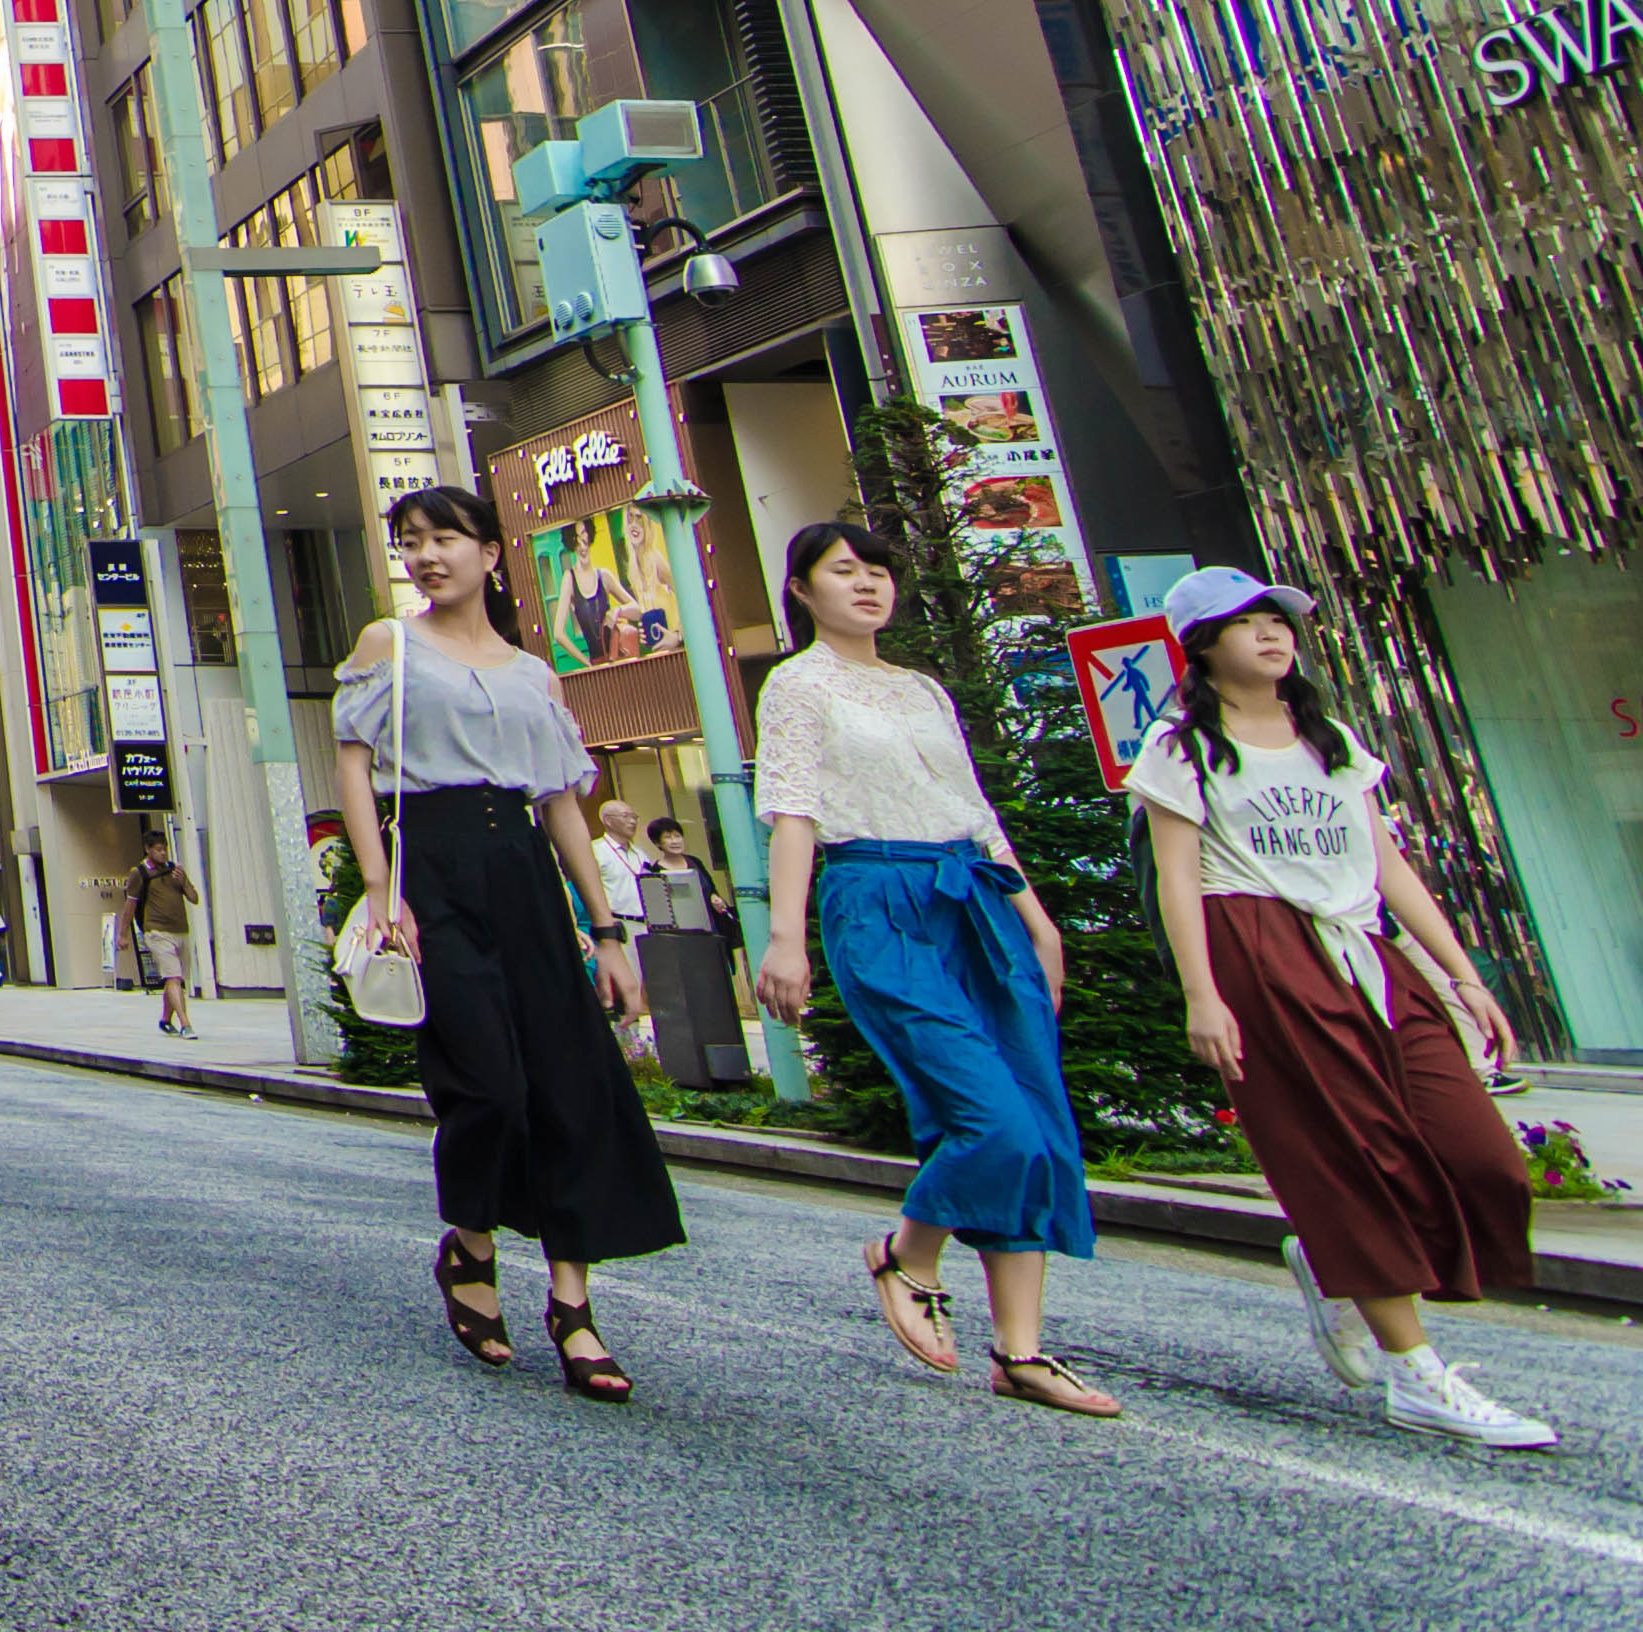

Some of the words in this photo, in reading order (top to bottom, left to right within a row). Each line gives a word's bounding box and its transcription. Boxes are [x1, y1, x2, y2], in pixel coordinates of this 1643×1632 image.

[941, 372, 1018, 388] AURUM
[378, 476, 434, 490] 長崎放送
[535, 445, 575, 506] Folli
[573, 430, 623, 484] Follie
[1247, 785, 1343, 822] LIBERTY
[1250, 825, 1312, 856] HANG
[1315, 826, 1349, 856] OUT
